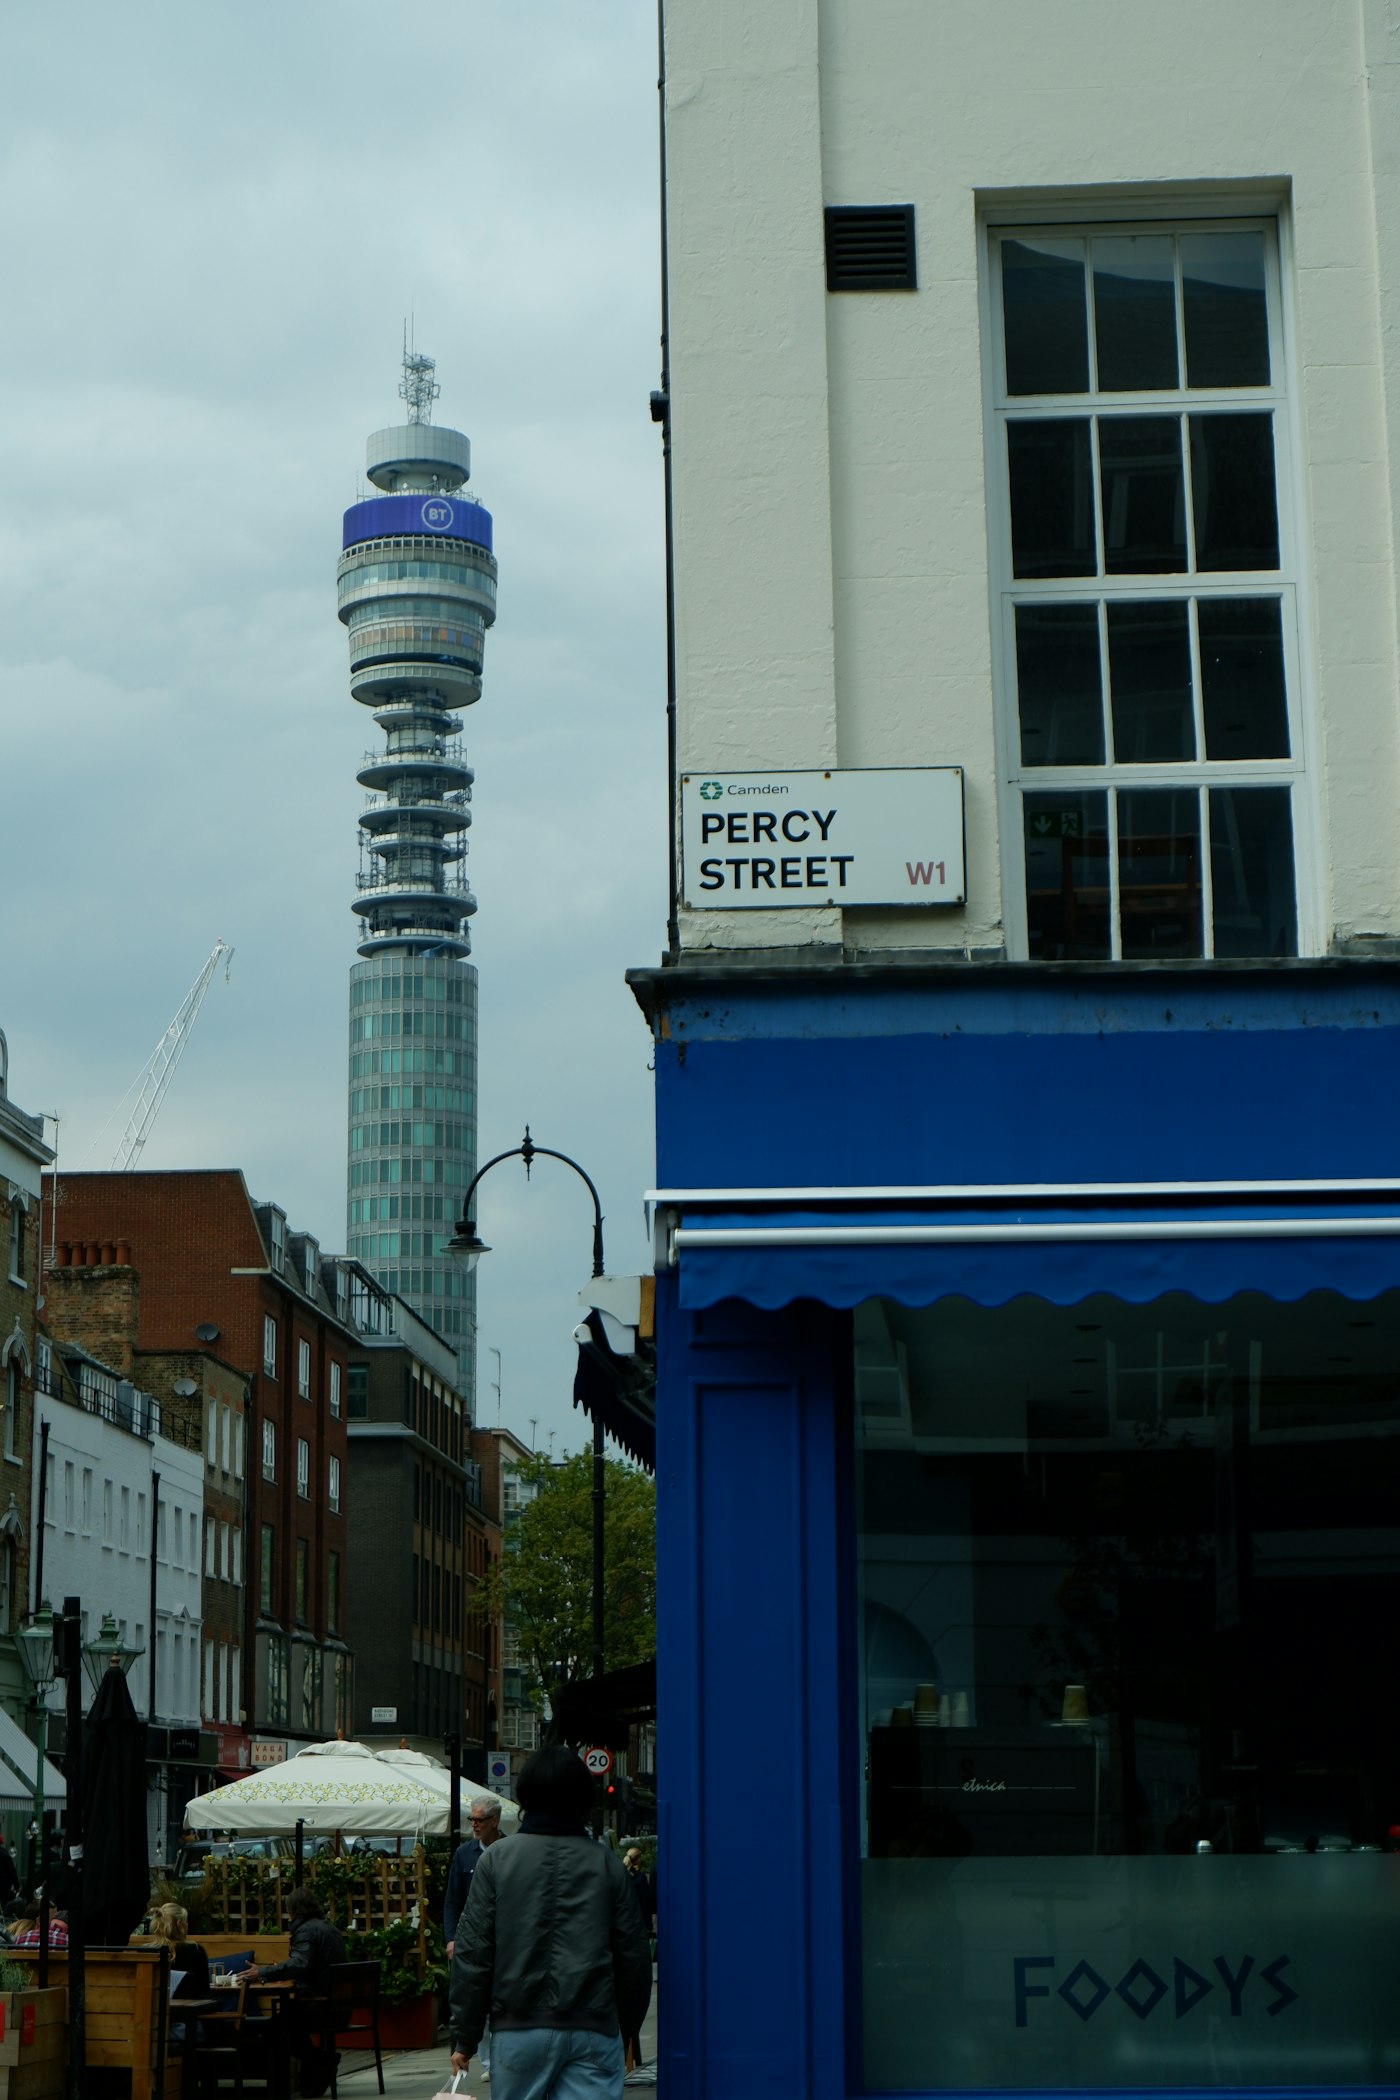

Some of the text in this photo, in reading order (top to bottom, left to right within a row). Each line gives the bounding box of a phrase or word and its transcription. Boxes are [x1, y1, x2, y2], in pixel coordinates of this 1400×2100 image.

[429, 508, 447, 520] BT
[727, 784, 789, 795] Camden
[701, 810, 837, 843] PERCY
[699, 855, 945, 889] STREET W1
[589, 1755, 608, 1767] 20
[1013, 1954, 1299, 2028] FOODYS
